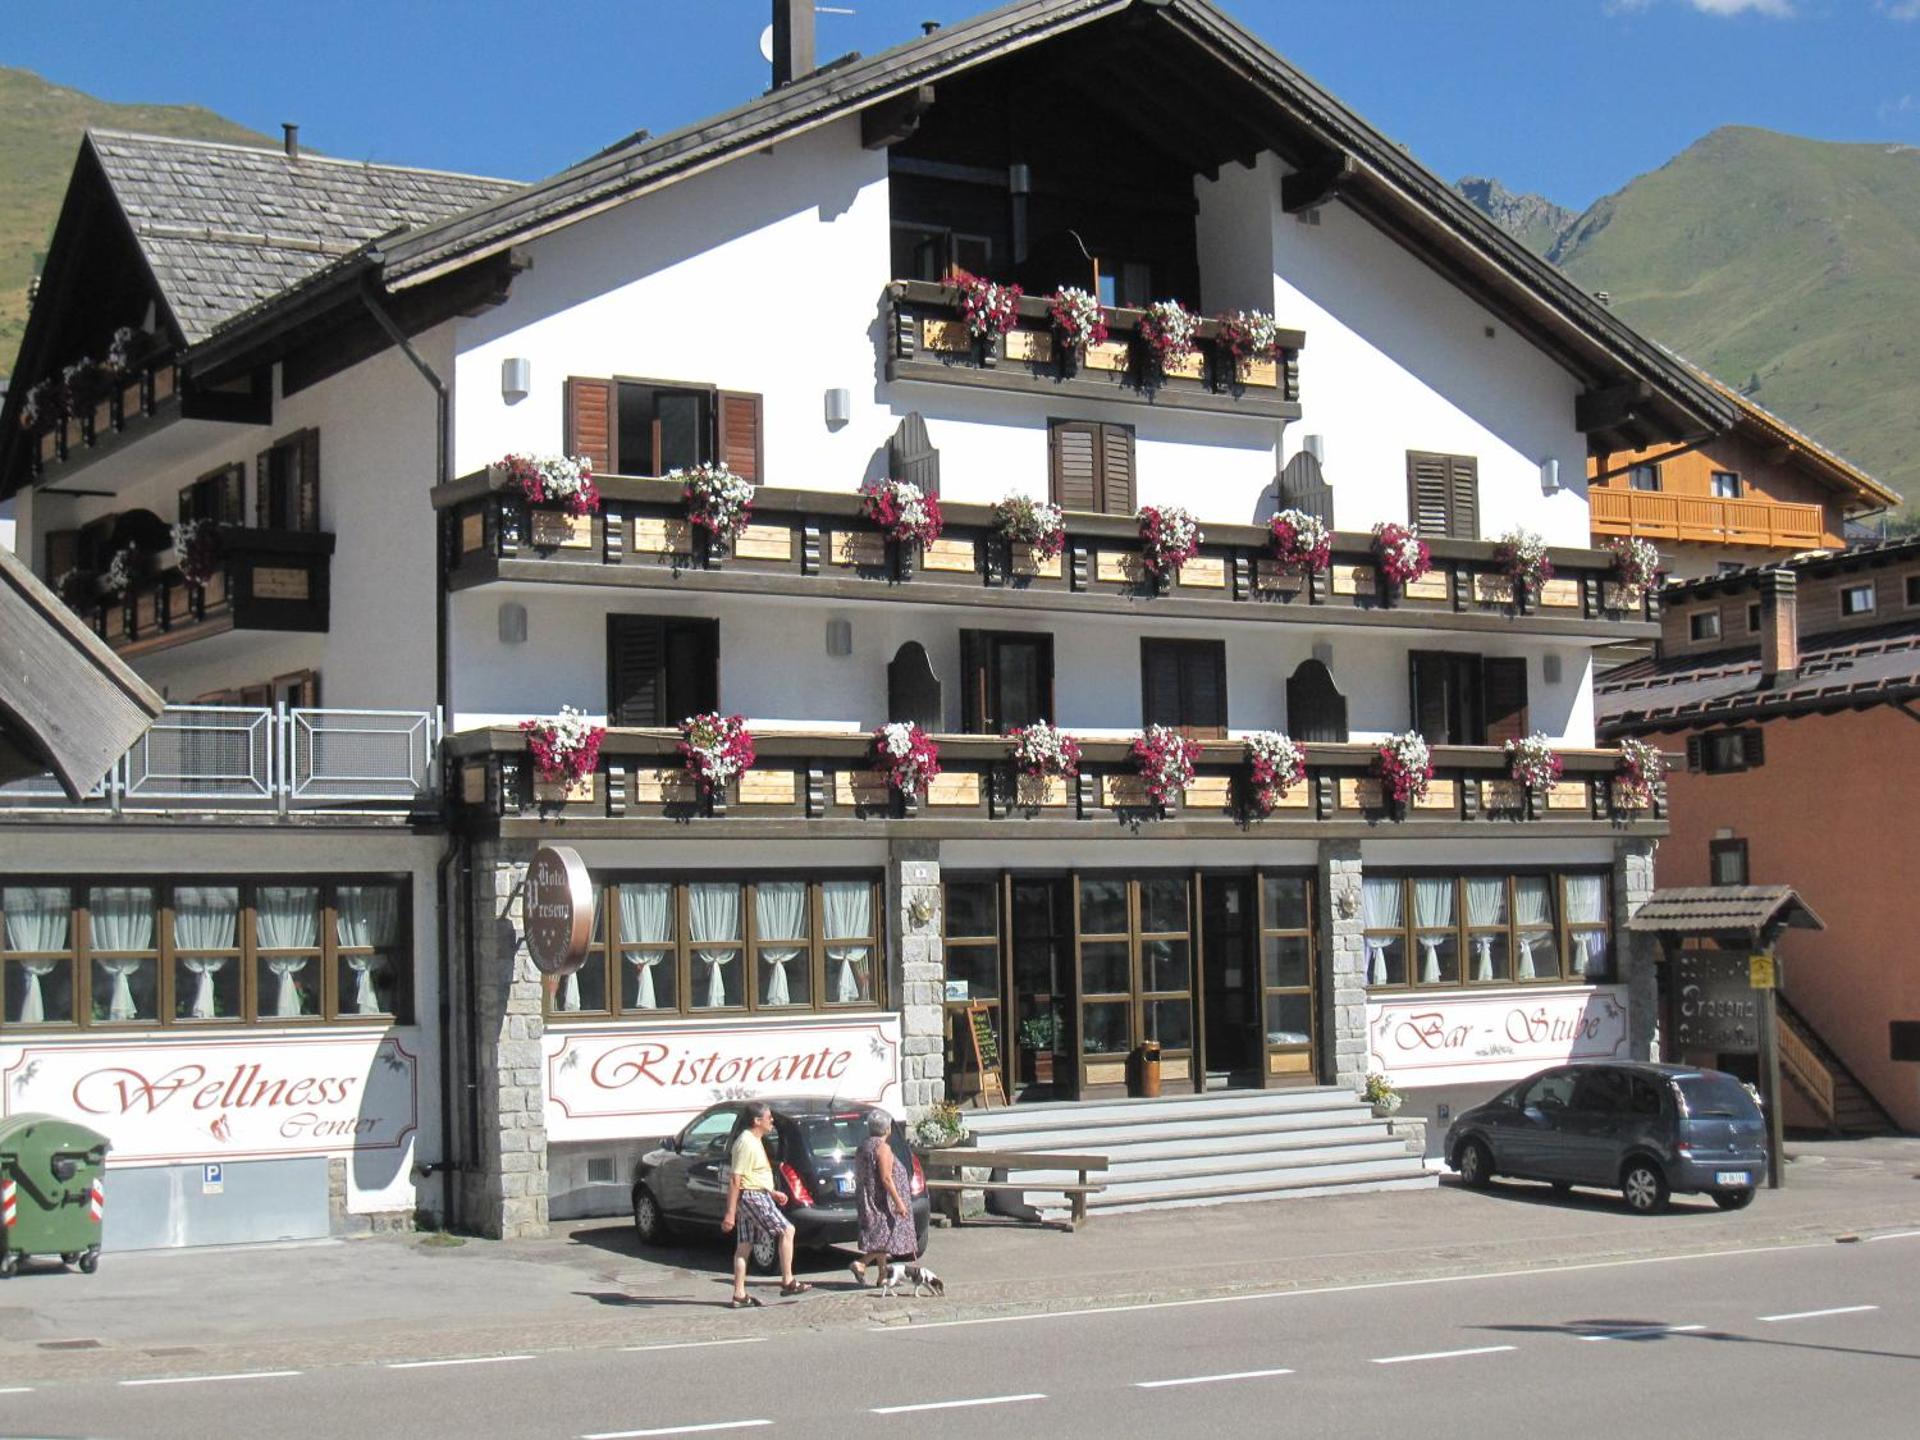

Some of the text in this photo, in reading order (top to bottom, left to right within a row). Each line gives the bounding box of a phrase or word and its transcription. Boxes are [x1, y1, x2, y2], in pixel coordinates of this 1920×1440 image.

[1395, 1012, 1474, 1051] Bar
[1505, 1007, 1602, 1045] Stube
[591, 1042, 853, 1090] Ristorante
[72, 1063, 358, 1115] Wellness
[279, 1111, 385, 1139] Center
[207, 1165, 220, 1181] P
